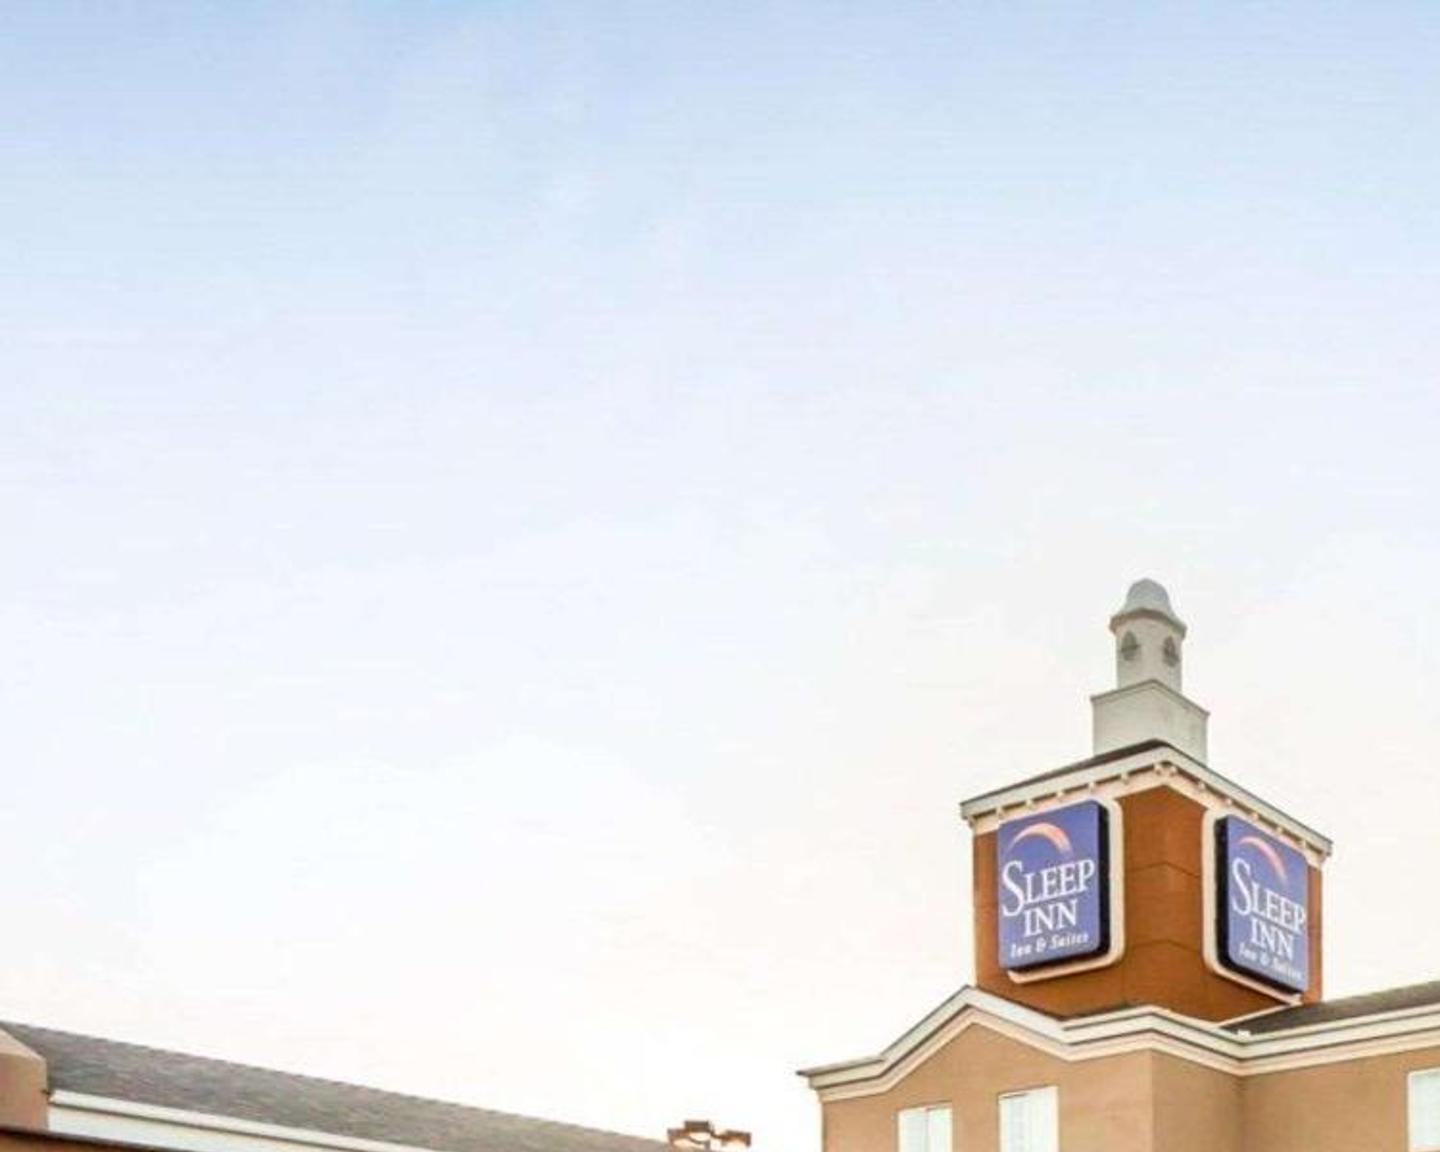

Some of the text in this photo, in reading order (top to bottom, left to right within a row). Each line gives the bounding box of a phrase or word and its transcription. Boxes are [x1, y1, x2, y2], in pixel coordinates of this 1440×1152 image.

[1002, 859, 1095, 917] SLEEP
[1232, 857, 1306, 934] SLEEP
[1024, 899, 1078, 937] INN
[1251, 918, 1295, 961] INN
